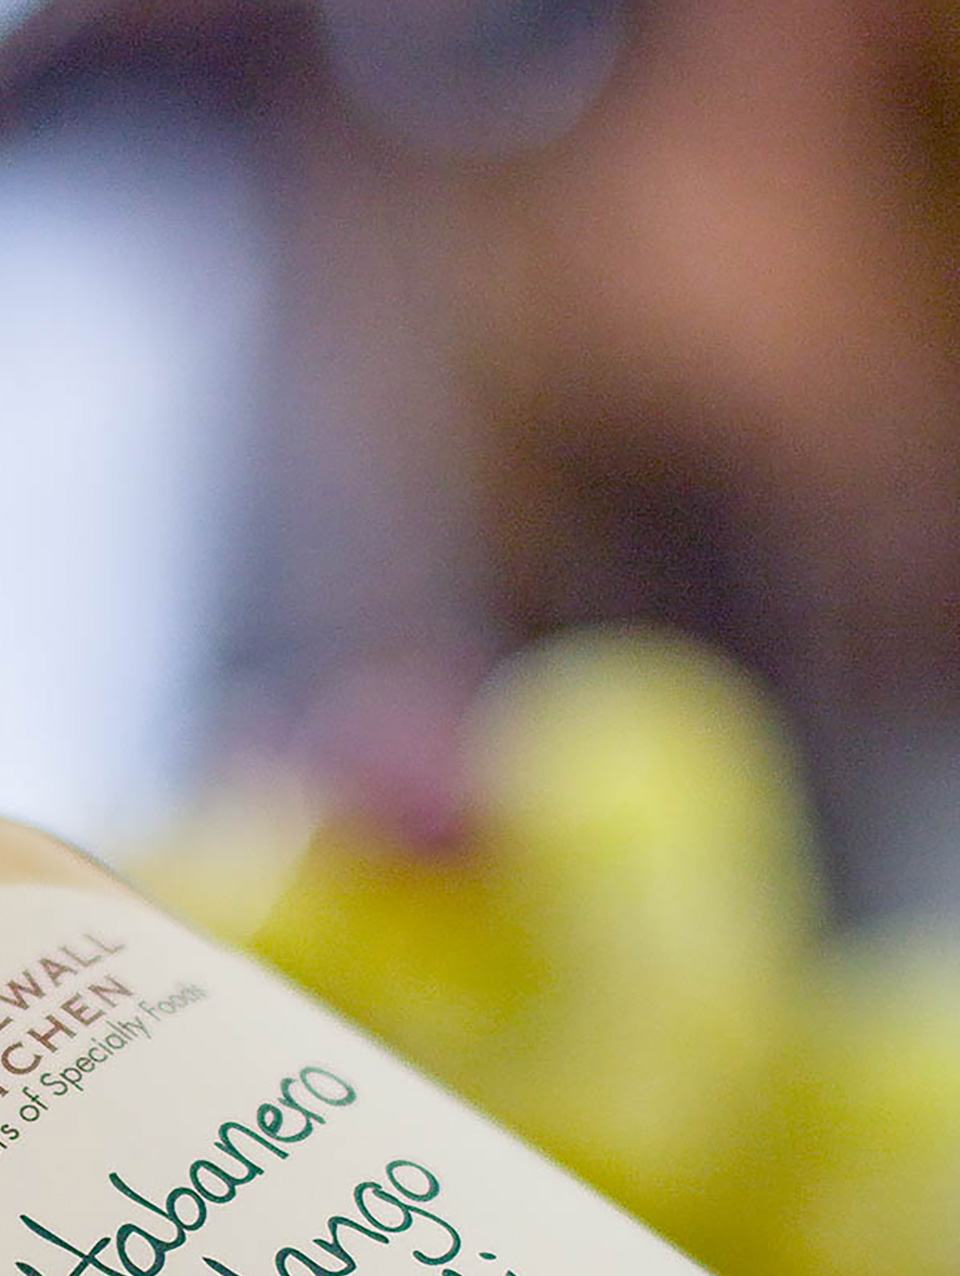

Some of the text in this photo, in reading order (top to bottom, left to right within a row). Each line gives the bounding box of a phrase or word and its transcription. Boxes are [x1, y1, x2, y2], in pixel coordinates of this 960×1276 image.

[18, 1085, 49, 1122] of
[39, 1016, 152, 1096] Specialty
[140, 980, 209, 1022] Foods
